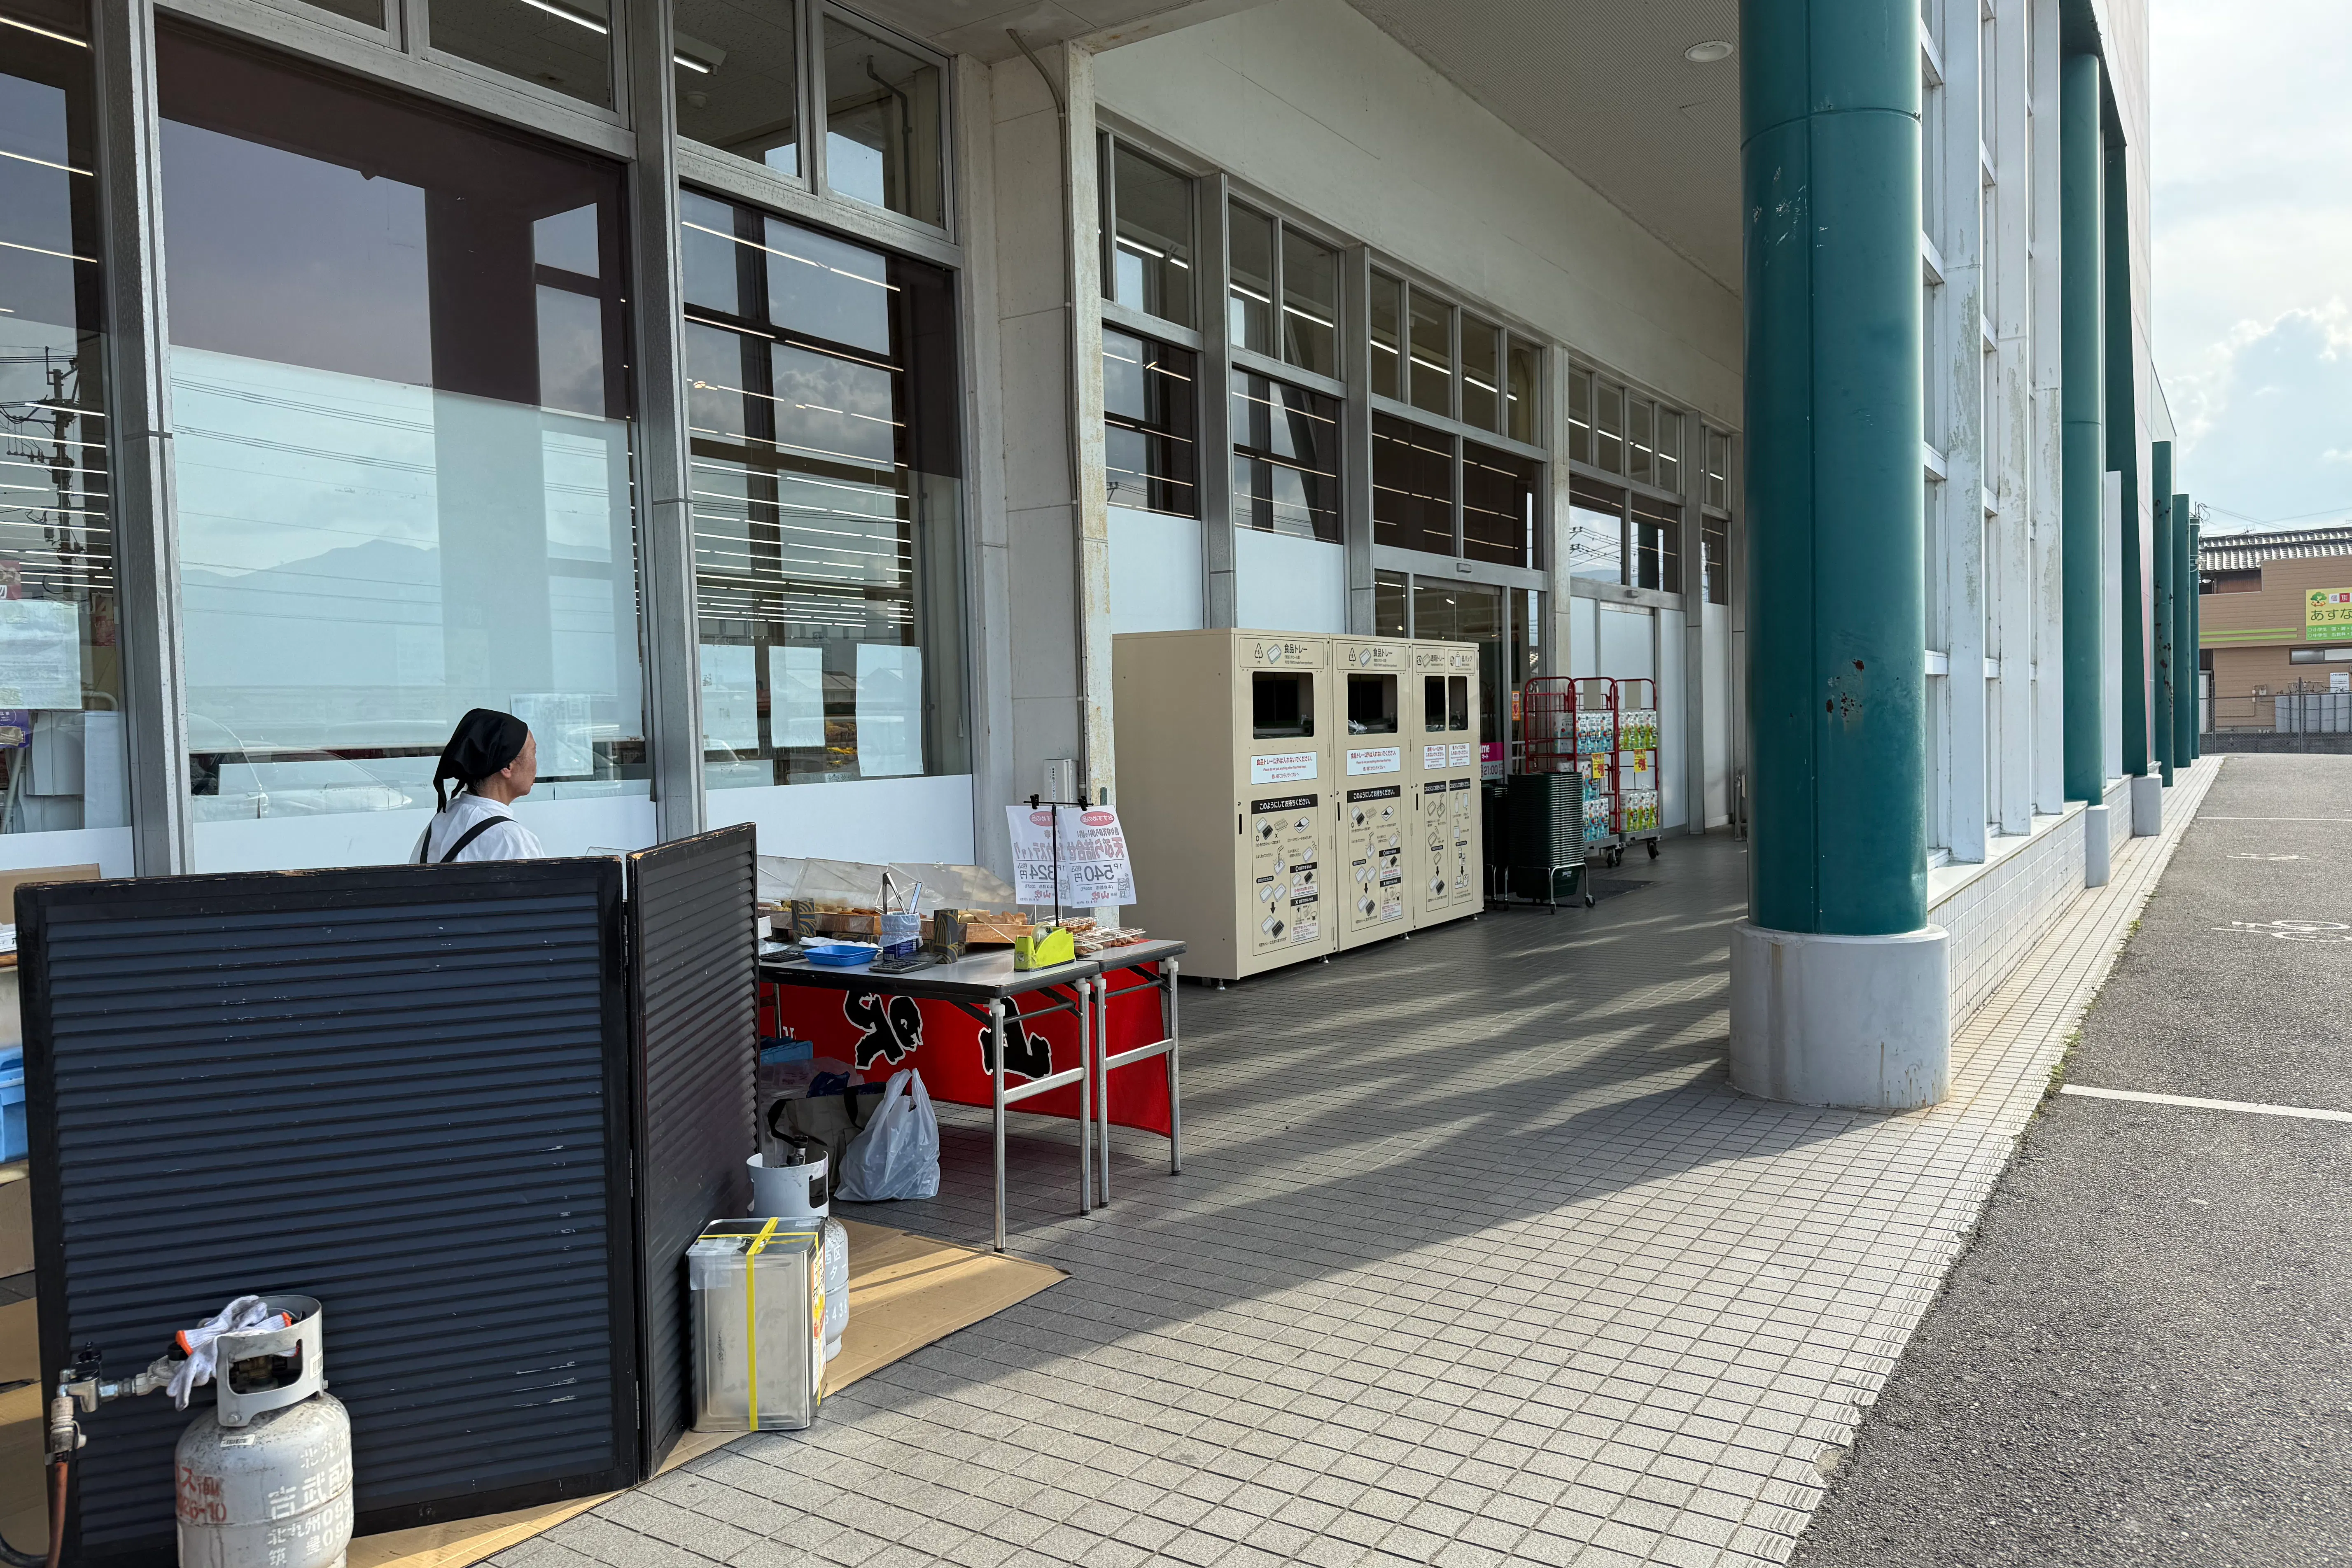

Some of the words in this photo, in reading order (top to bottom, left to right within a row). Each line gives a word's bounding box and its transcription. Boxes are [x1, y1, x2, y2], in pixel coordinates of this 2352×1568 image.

[2310, 608, 2352, 621] あすな
[1284, 643, 1308, 654] 食品トレー
[1373, 648, 1393, 657] 食品トレー
[1256, 755, 1313, 766] 食品トレー以外は入れないでください。
[1484, 765, 1498, 775] 21:00
[1259, 798, 1311, 810] このようにしてお持ちください。
